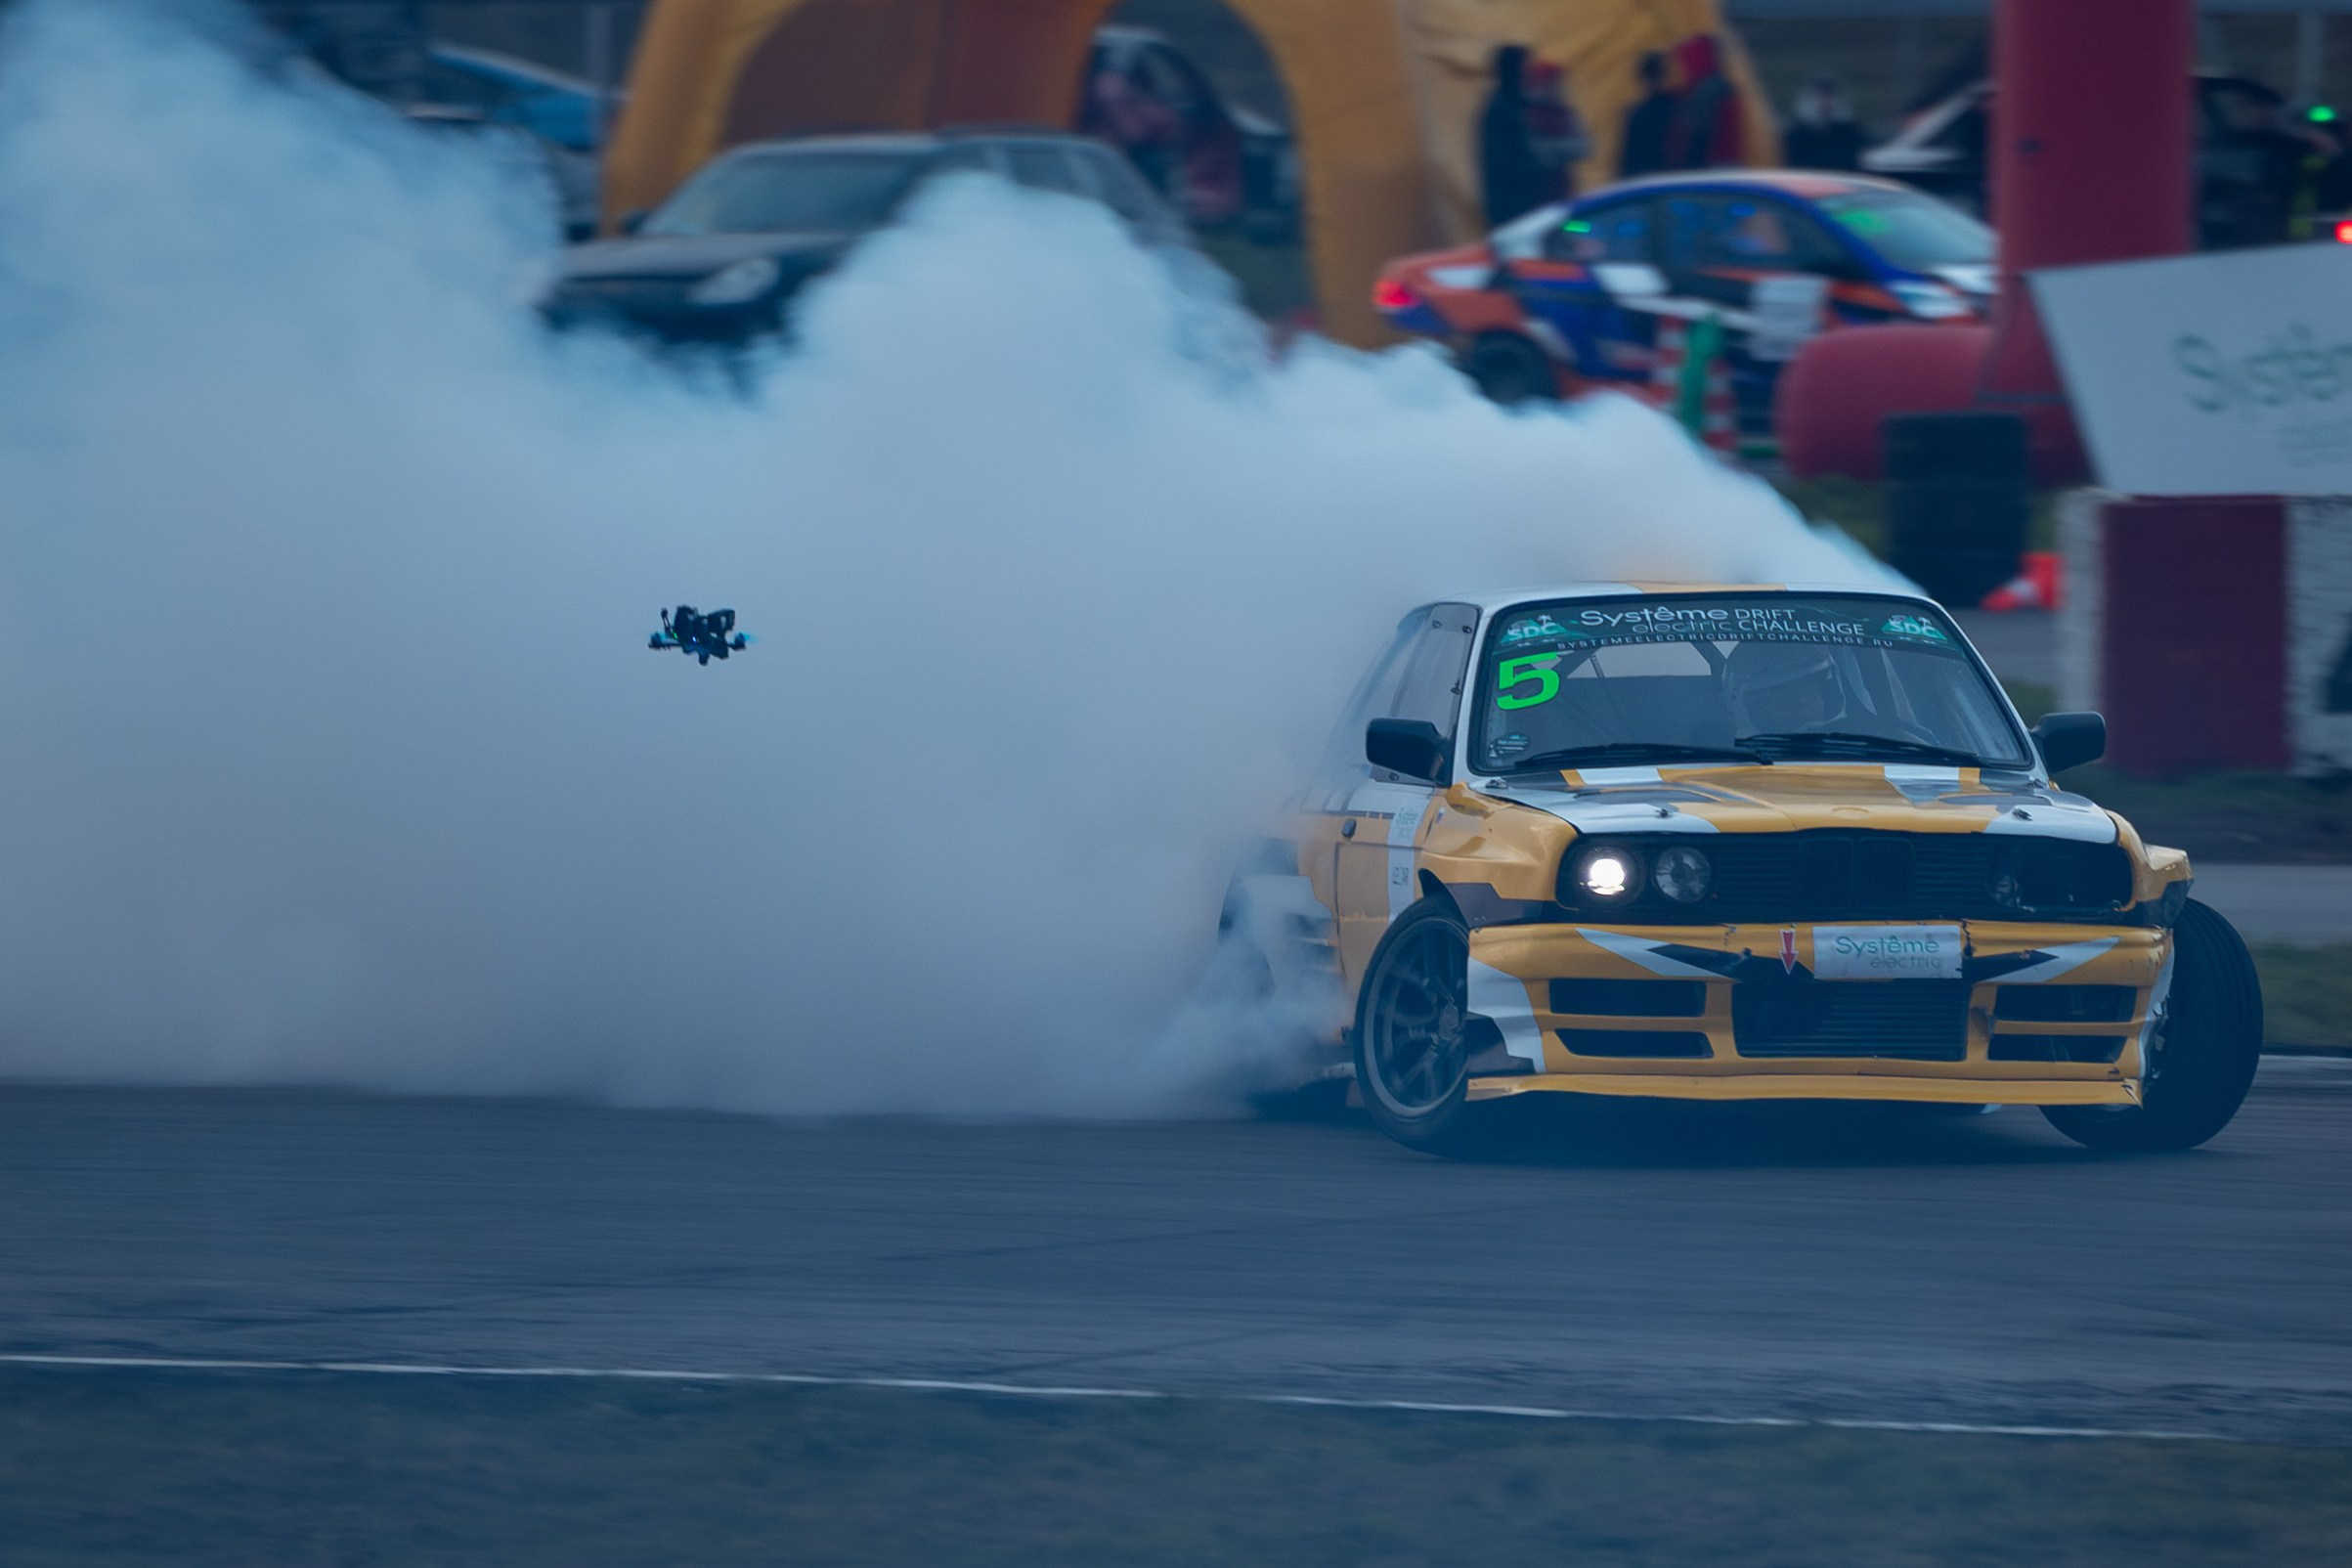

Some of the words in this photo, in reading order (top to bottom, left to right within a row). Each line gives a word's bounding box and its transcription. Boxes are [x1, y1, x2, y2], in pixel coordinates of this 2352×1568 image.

[1734, 608, 1796, 621] DRIFT
[1508, 622, 1559, 641] SDC
[1632, 619, 1731, 634] electric
[1737, 619, 1865, 636] CHALLENGE
[1889, 621, 1938, 636] SDC
[1497, 651, 1560, 711] 5
[1869, 954, 1942, 969] electric
